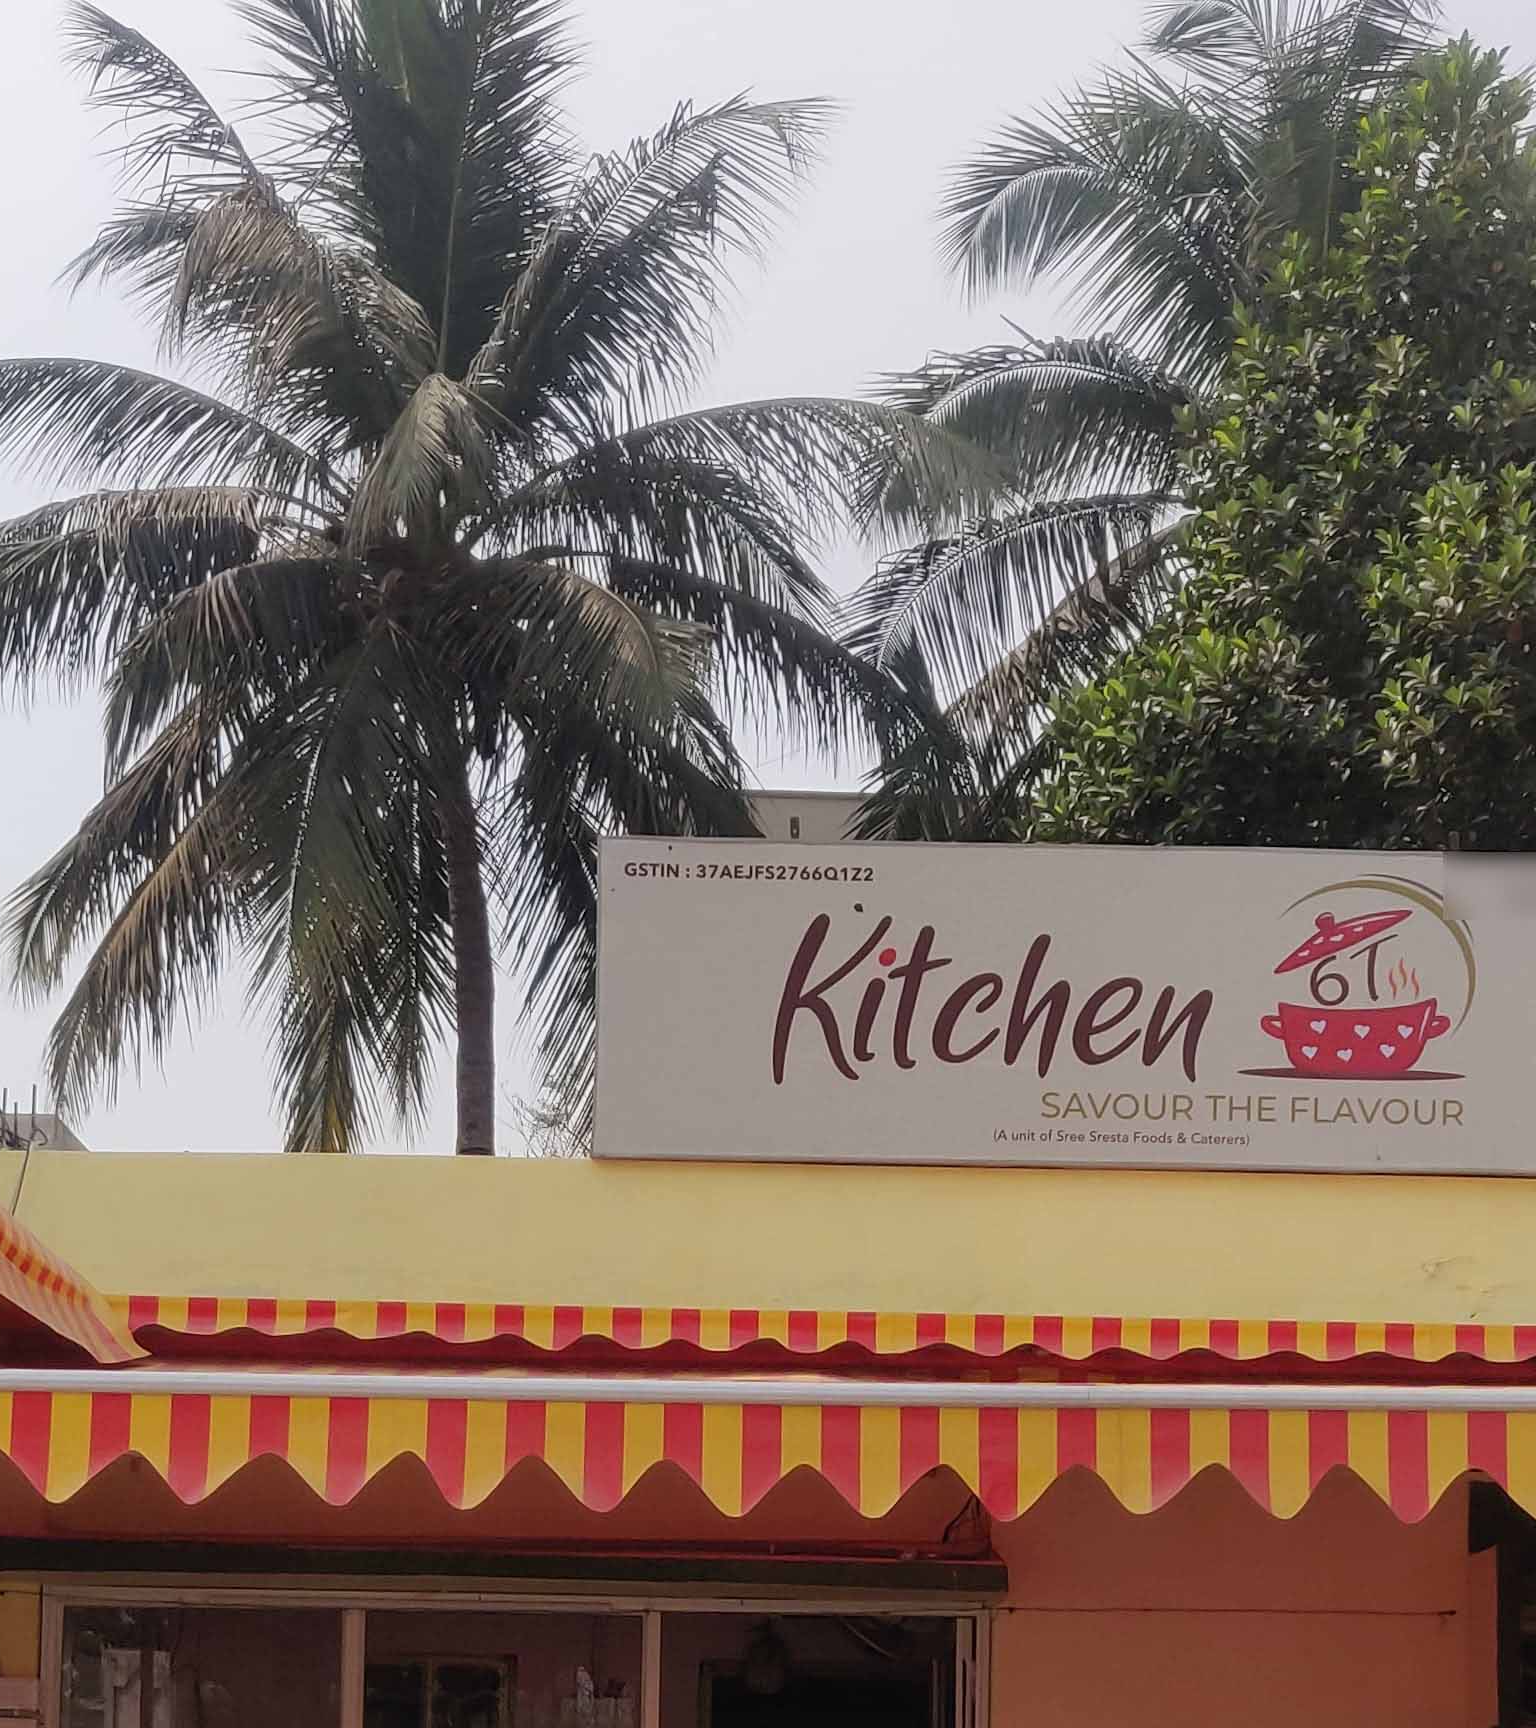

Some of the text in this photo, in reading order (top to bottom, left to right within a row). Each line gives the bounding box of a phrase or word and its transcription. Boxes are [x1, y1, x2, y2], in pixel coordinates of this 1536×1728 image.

[624, 862, 680, 879] GSTIN
[695, 864, 874, 882] 37AEJFS2766Q1Z2
[772, 912, 1214, 1085] Kitchen
[1039, 1091, 1464, 1127] SAVOUR THE FLAVOUR
[993, 1128, 1251, 1147] (A unit of Sree Sresta Foods & Caterers)
